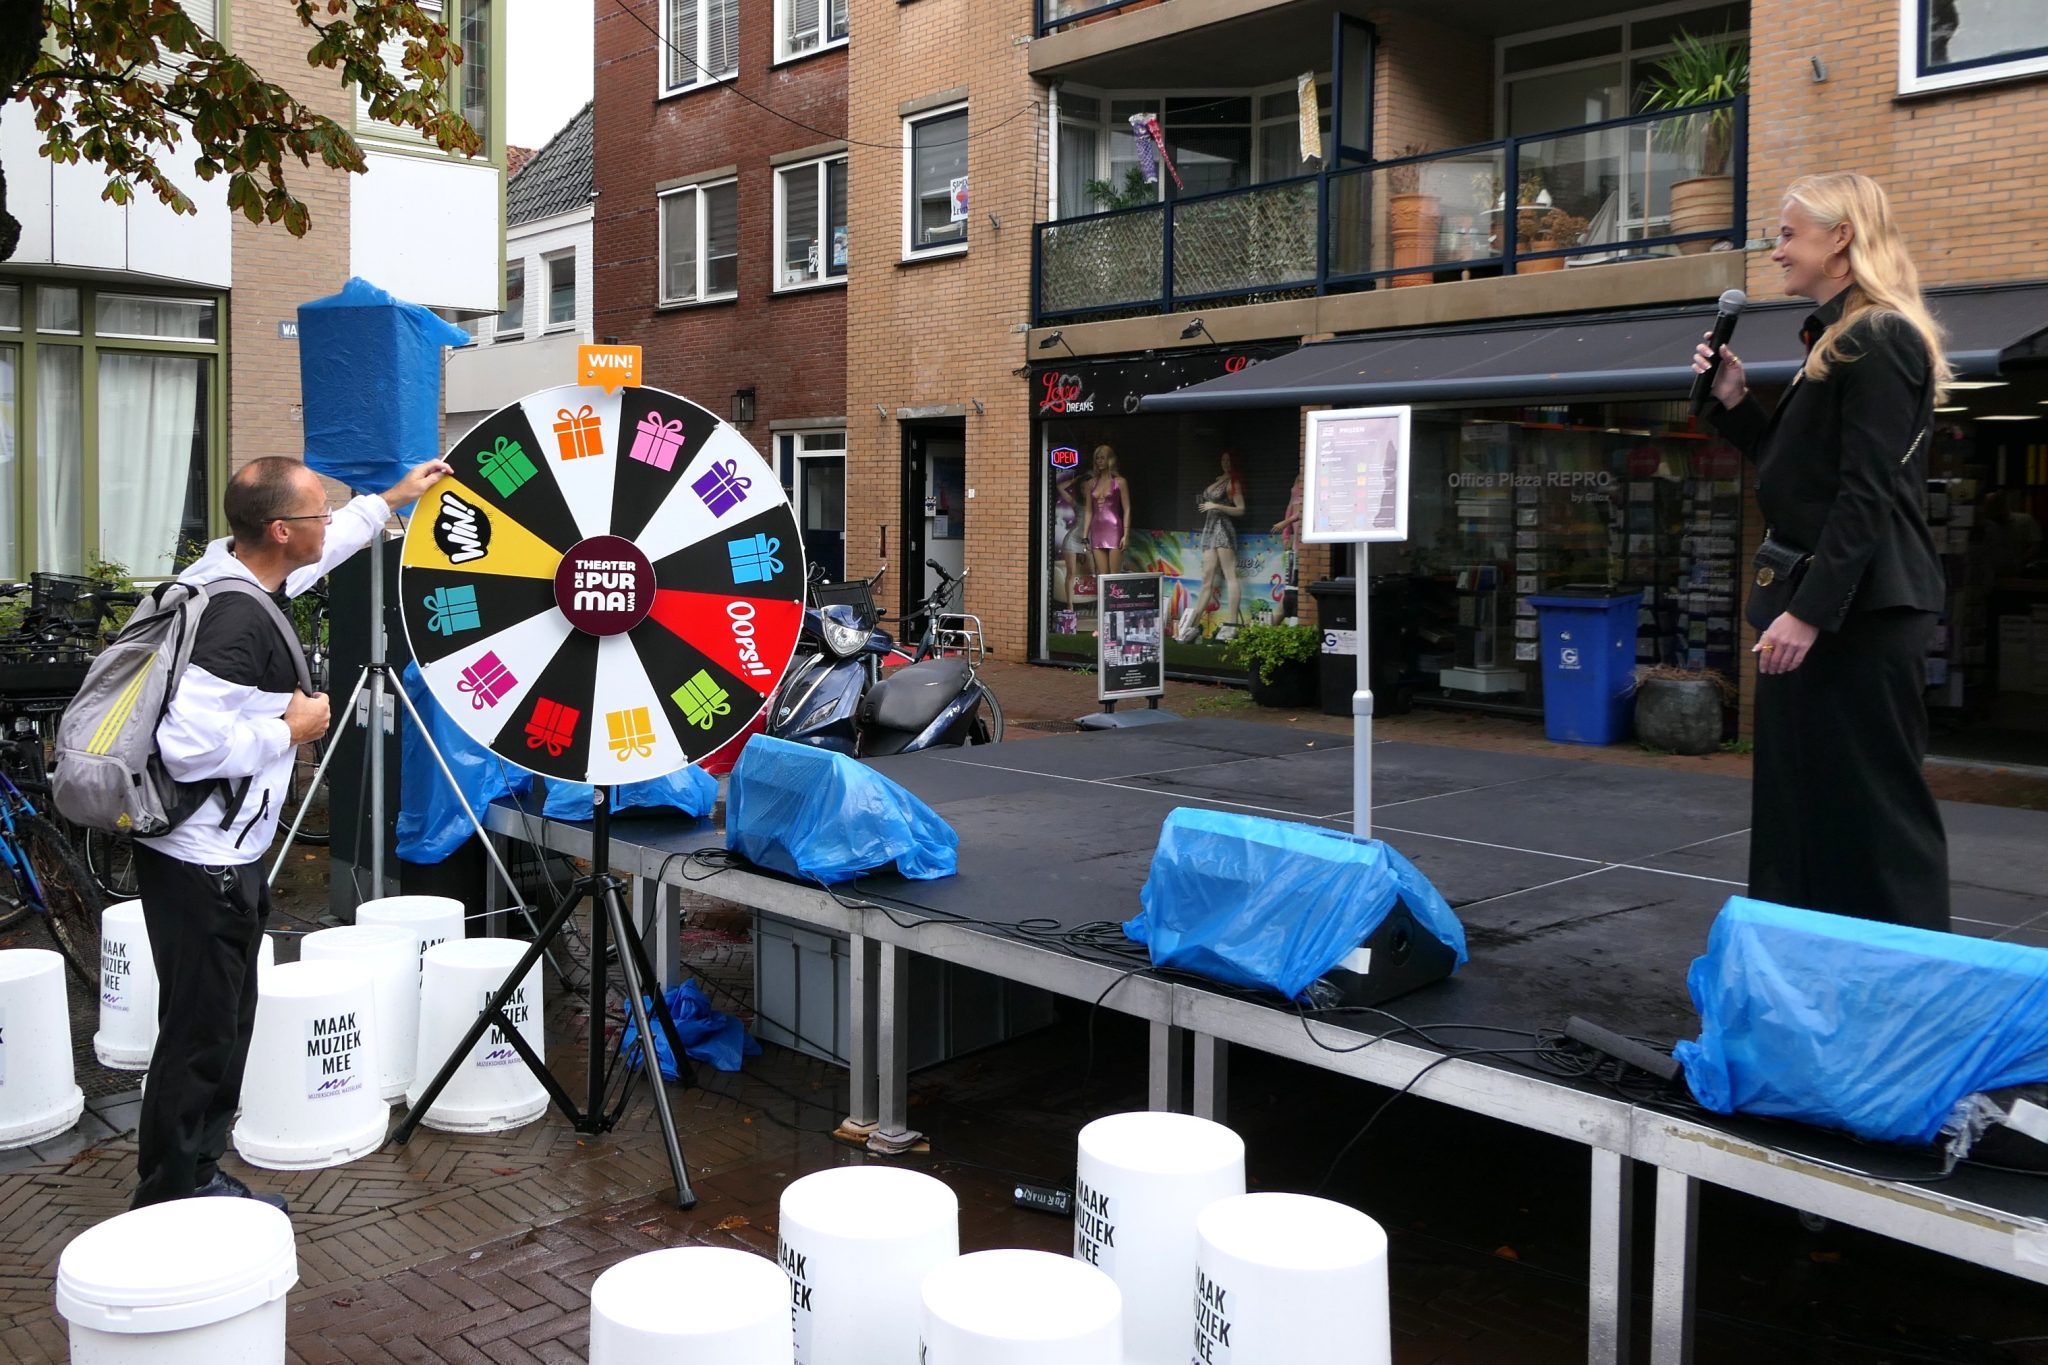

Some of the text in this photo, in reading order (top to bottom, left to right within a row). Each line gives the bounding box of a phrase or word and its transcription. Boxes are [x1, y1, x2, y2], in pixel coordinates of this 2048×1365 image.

[588, 353, 634, 369] WIN!
[1040, 372, 1081, 413] Love
[1066, 401, 1094, 413] DREAMS
[1054, 451, 1076, 464] OPEN
[1448, 471, 1610, 488] Office Plaza REPRO
[575, 560, 636, 571] THEATER
[574, 572, 584, 589] DE
[586, 572, 636, 590] PUR
[574, 590, 626, 611] MA
[103, 938, 127, 958] MAAK
[104, 973, 120, 991] MEE
[485, 987, 525, 1009] MAK
[314, 1012, 356, 1036] MAAK
[479, 1005, 529, 1025] ZIEK
[307, 1030, 361, 1057] MUZIEK
[322, 1053, 351, 1075] MEE
[1078, 1176, 1109, 1219] MAAK
[1078, 1231, 1099, 1267] MEE
